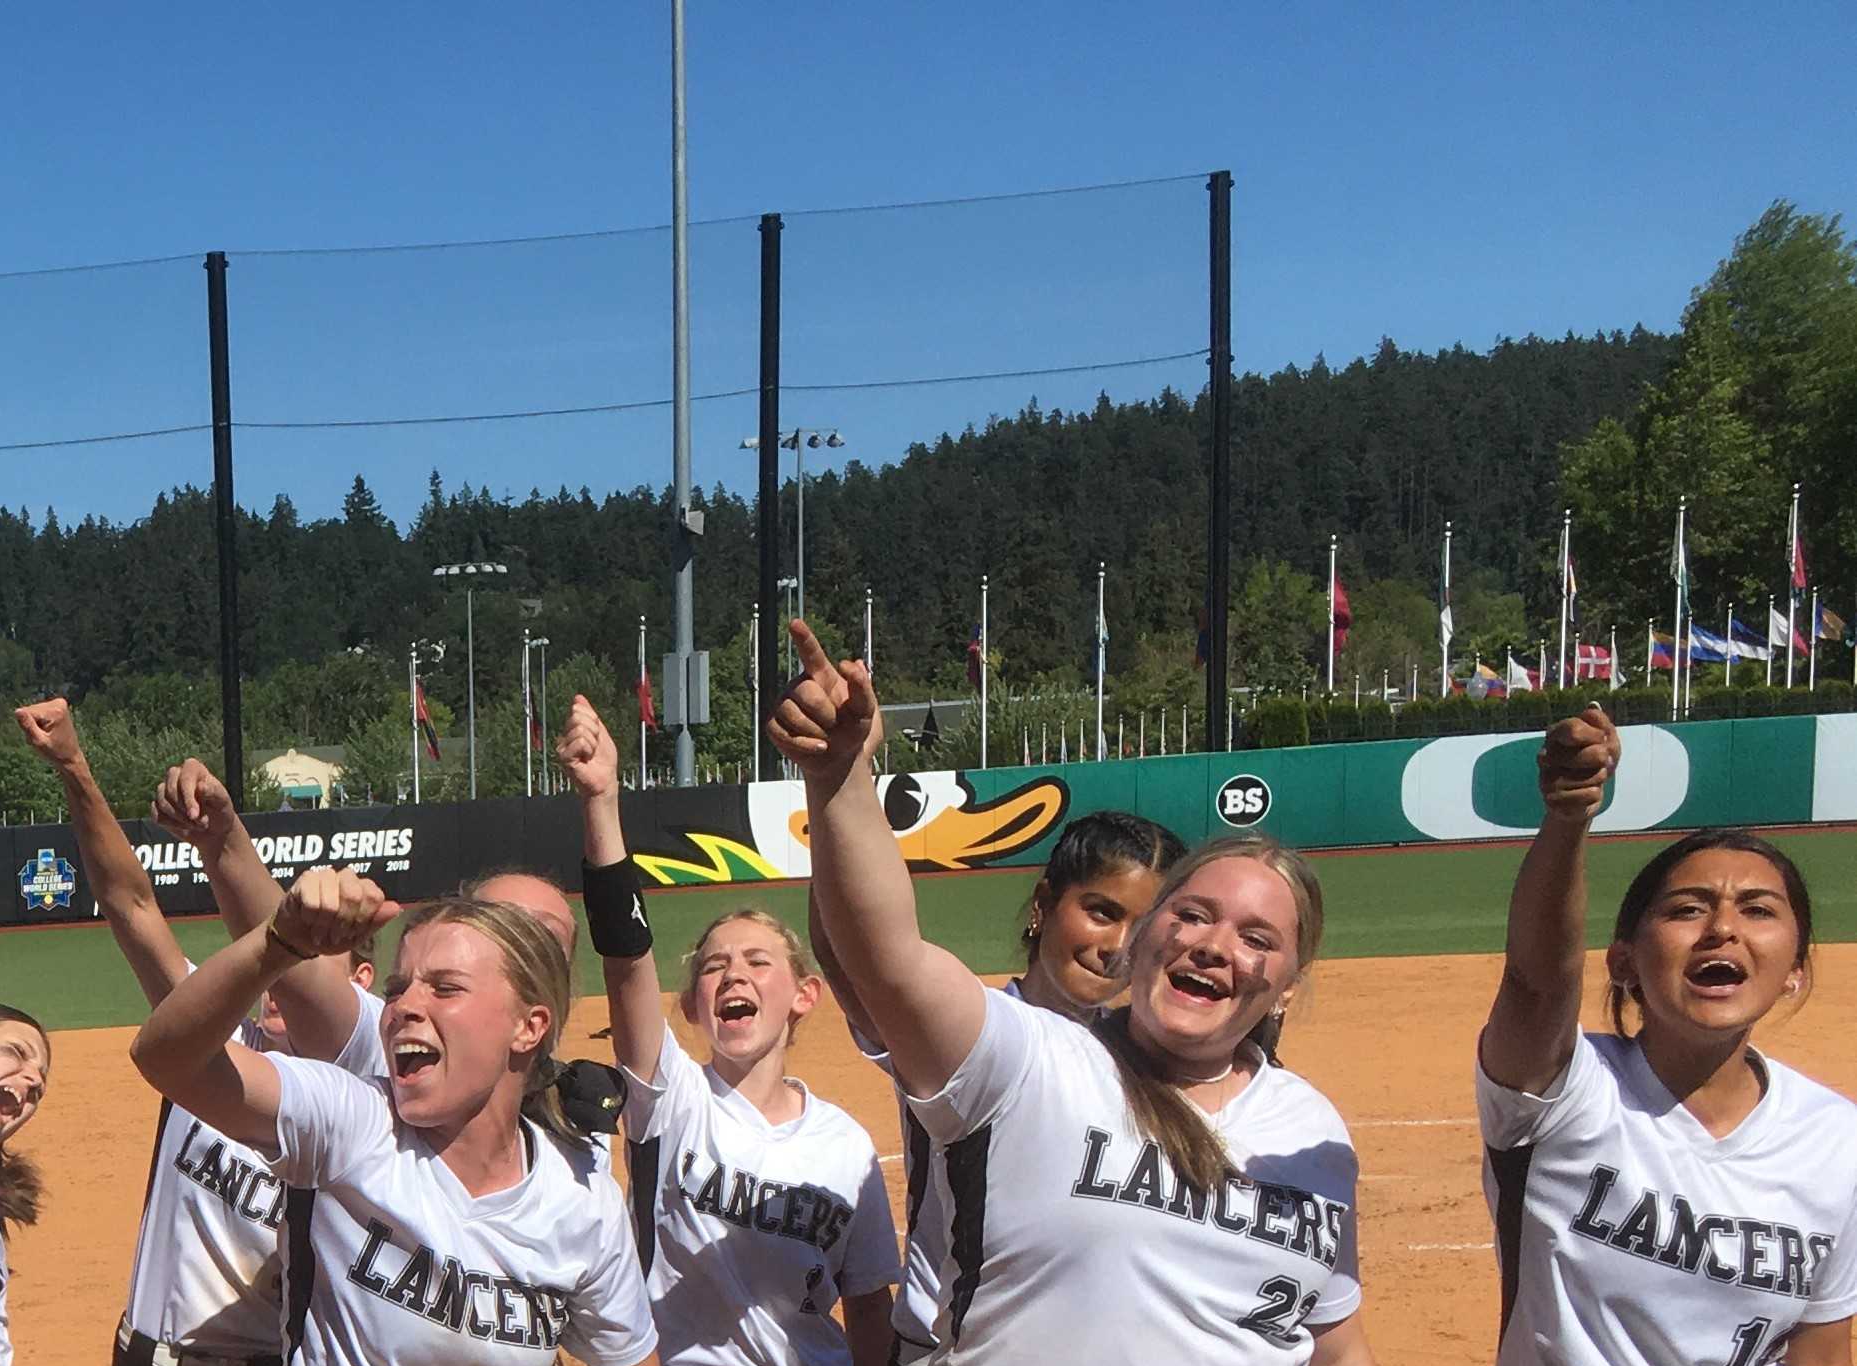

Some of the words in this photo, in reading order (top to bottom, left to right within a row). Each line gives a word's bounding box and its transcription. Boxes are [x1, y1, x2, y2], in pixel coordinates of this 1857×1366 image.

[1224, 787, 1263, 814] BS
[252, 834, 324, 865] ORLD
[329, 828, 414, 860] SERIES
[154, 873, 180, 886] 1980
[271, 866, 295, 879] 2014
[385, 860, 411, 873] 2018
[679, 1148, 855, 1252] LANCERS
[1070, 1126, 1349, 1272] LANCERS
